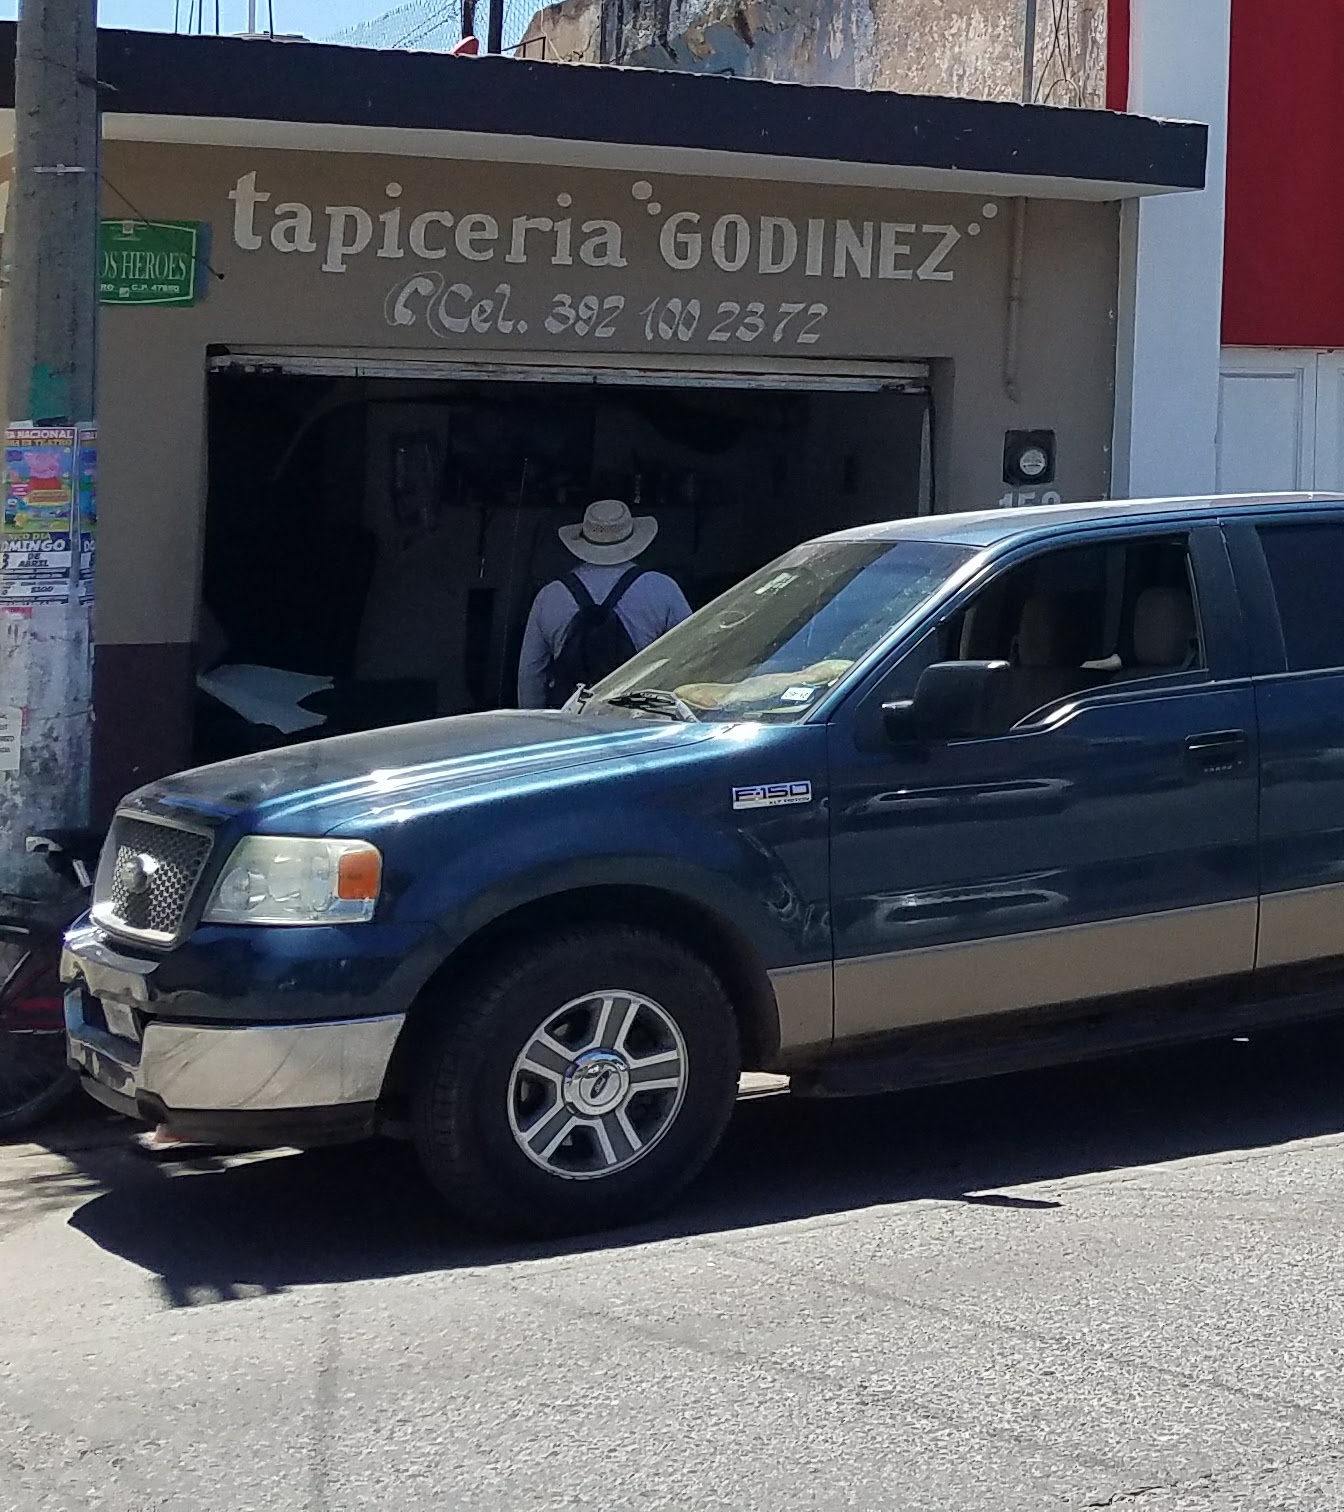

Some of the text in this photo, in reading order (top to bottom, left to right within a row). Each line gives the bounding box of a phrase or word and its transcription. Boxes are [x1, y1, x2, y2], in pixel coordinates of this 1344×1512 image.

[228, 171, 962, 283] tapiceria GODINEZ
[121, 251, 188, 281] HEROES
[437, 283, 528, 335] Cel.
[545, 293, 626, 338] 392
[638, 295, 702, 342] 100
[2, 539, 66, 552] OMINGO
